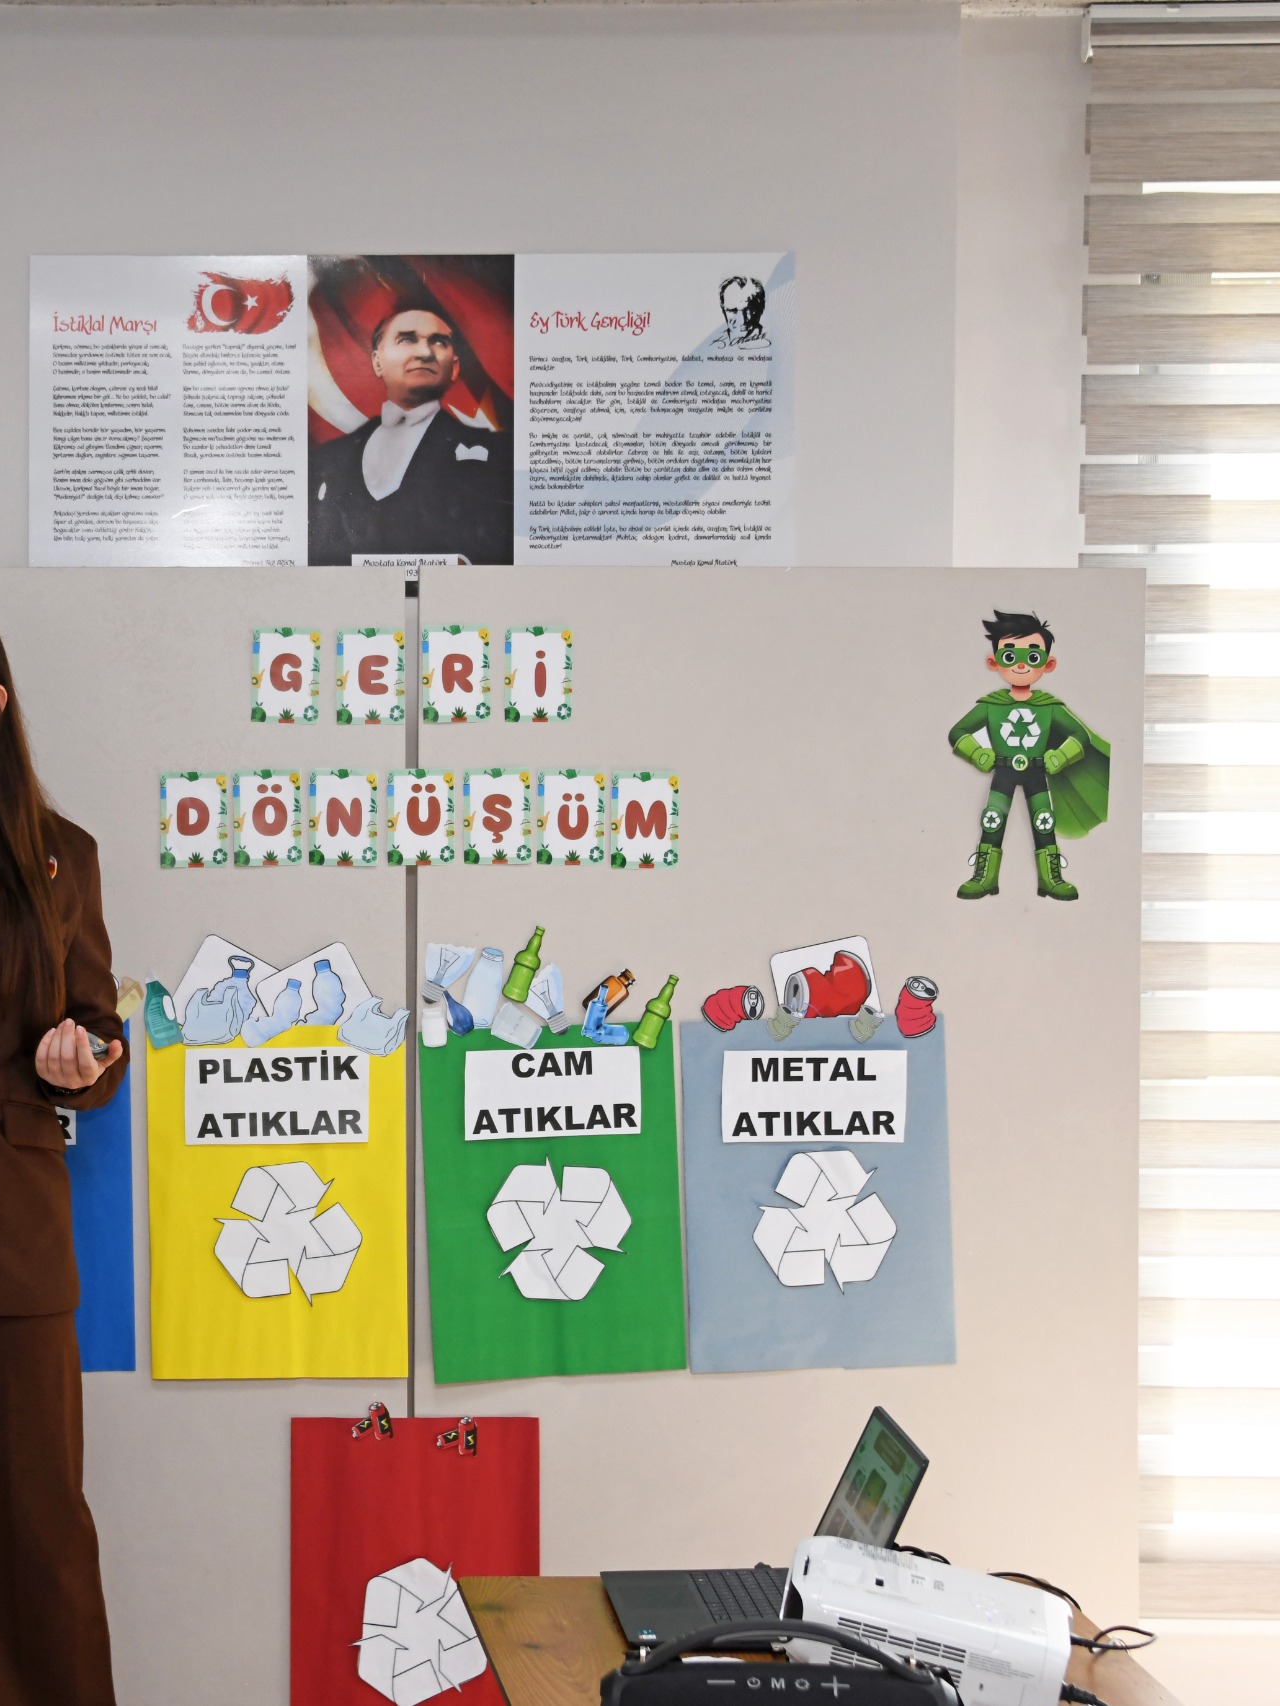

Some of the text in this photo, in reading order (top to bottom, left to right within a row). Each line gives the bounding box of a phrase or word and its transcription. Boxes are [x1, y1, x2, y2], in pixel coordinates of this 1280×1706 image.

[52, 311, 157, 336] İstiklal Marşı
[529, 310, 651, 336] Ey Türk Gençliği!
[406, 569, 419, 577] 193
[270, 650, 546, 698] GERİ
[176, 784, 667, 843] DÖNÜŞÜM
[199, 1050, 360, 1084] PLASTİK
[512, 1051, 593, 1078] CAM
[751, 1057, 877, 1082] METAL
[197, 1109, 363, 1138] ATIKLAR
[472, 1103, 638, 1134] ATIKLAR
[732, 1111, 896, 1137] ATIKLAR
[771, 1678, 786, 1690] M
